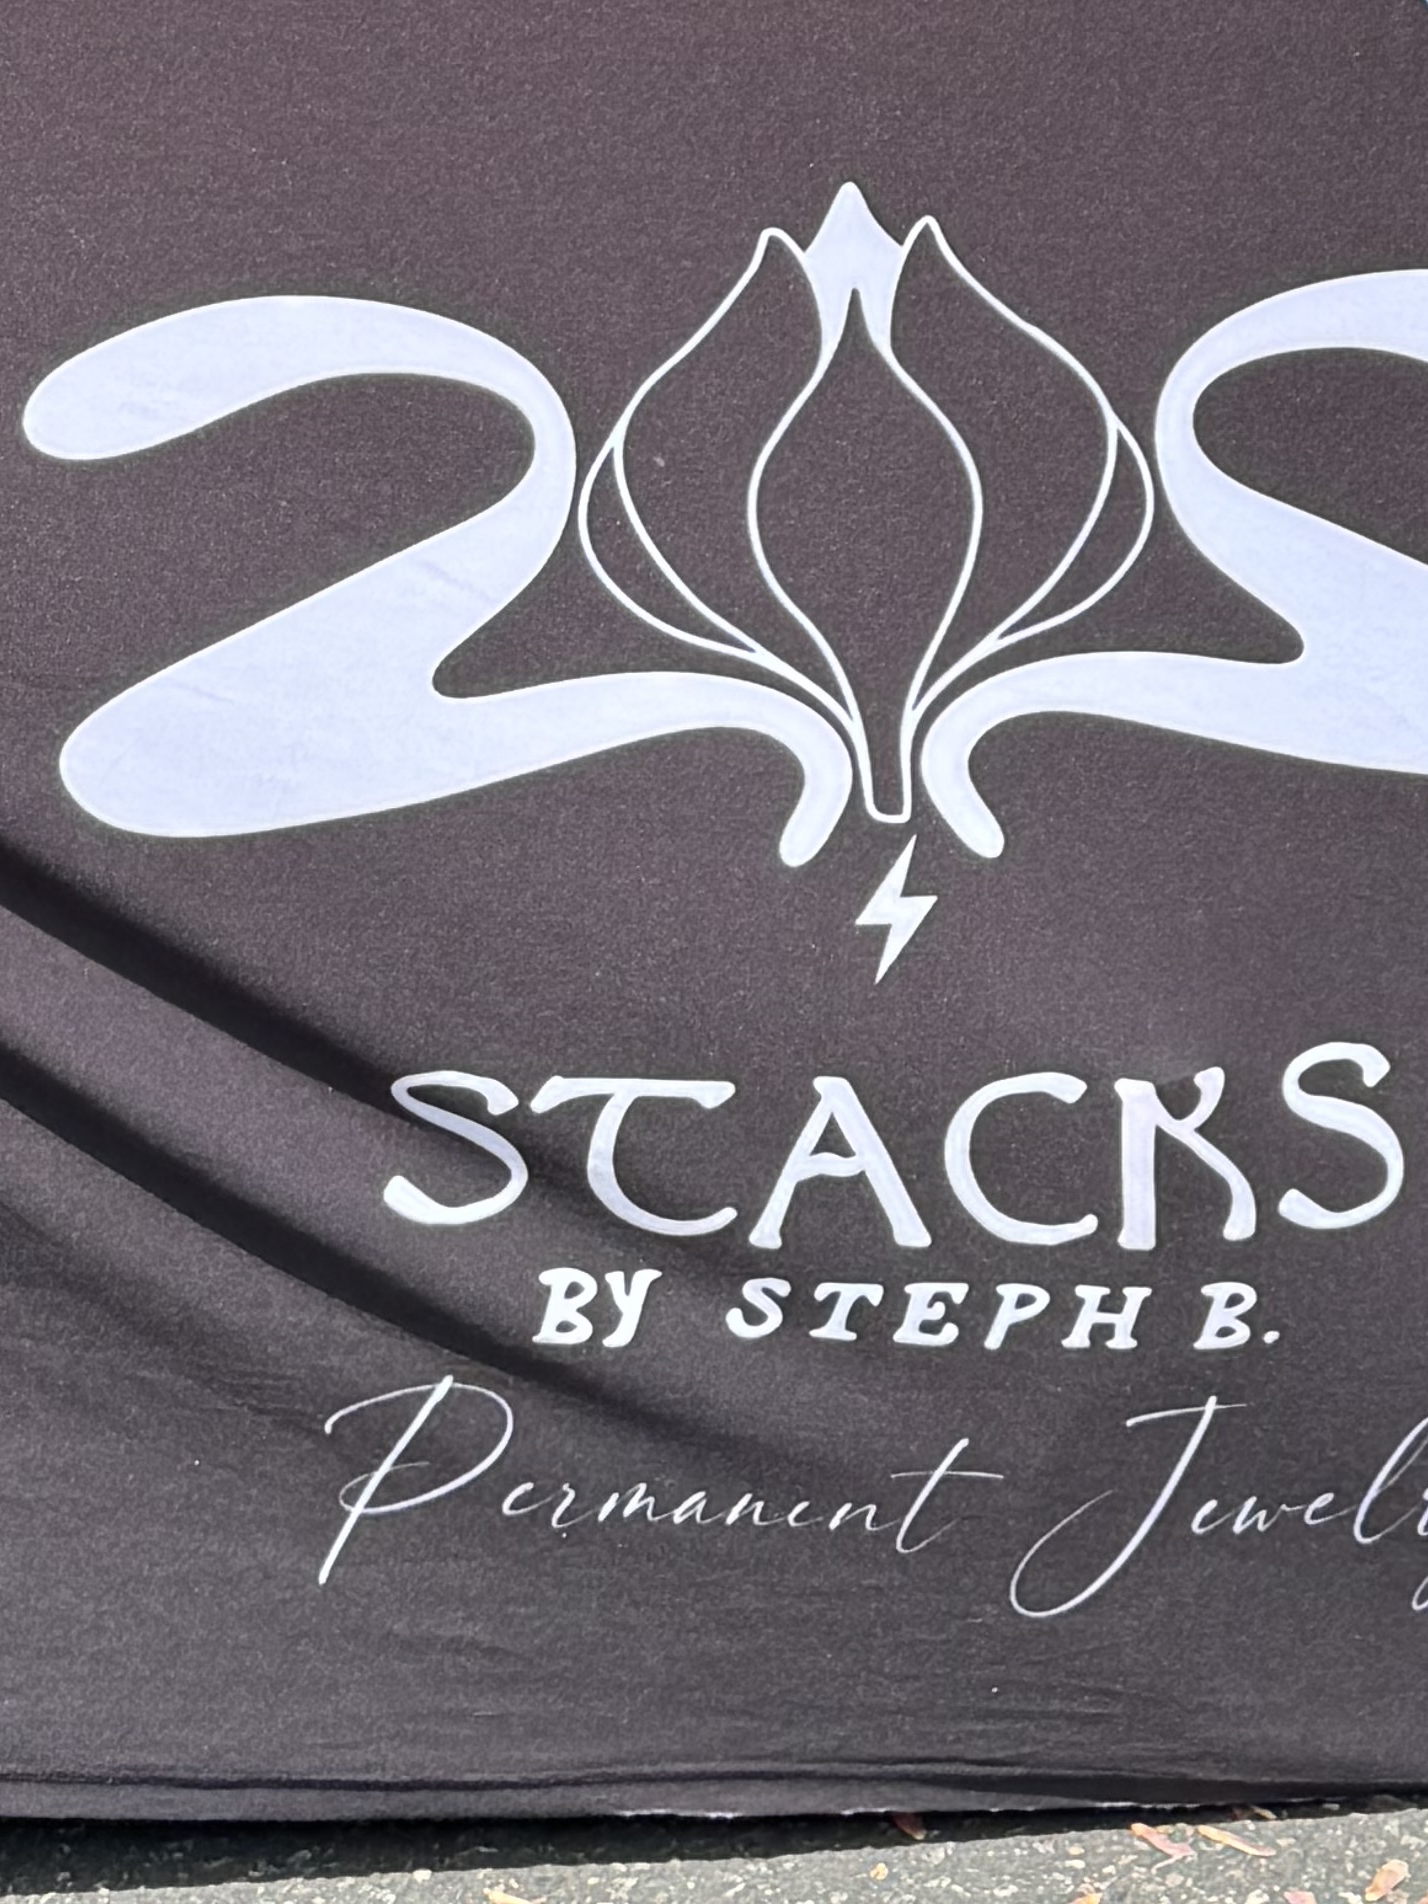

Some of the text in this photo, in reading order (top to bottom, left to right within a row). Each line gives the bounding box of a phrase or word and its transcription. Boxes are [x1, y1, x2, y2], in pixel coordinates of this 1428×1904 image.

[383, 1039, 1407, 1251] STACKS
[531, 1266, 1281, 1351] BY STEPH B.
[318, 1374, 1005, 1586] Permanent
